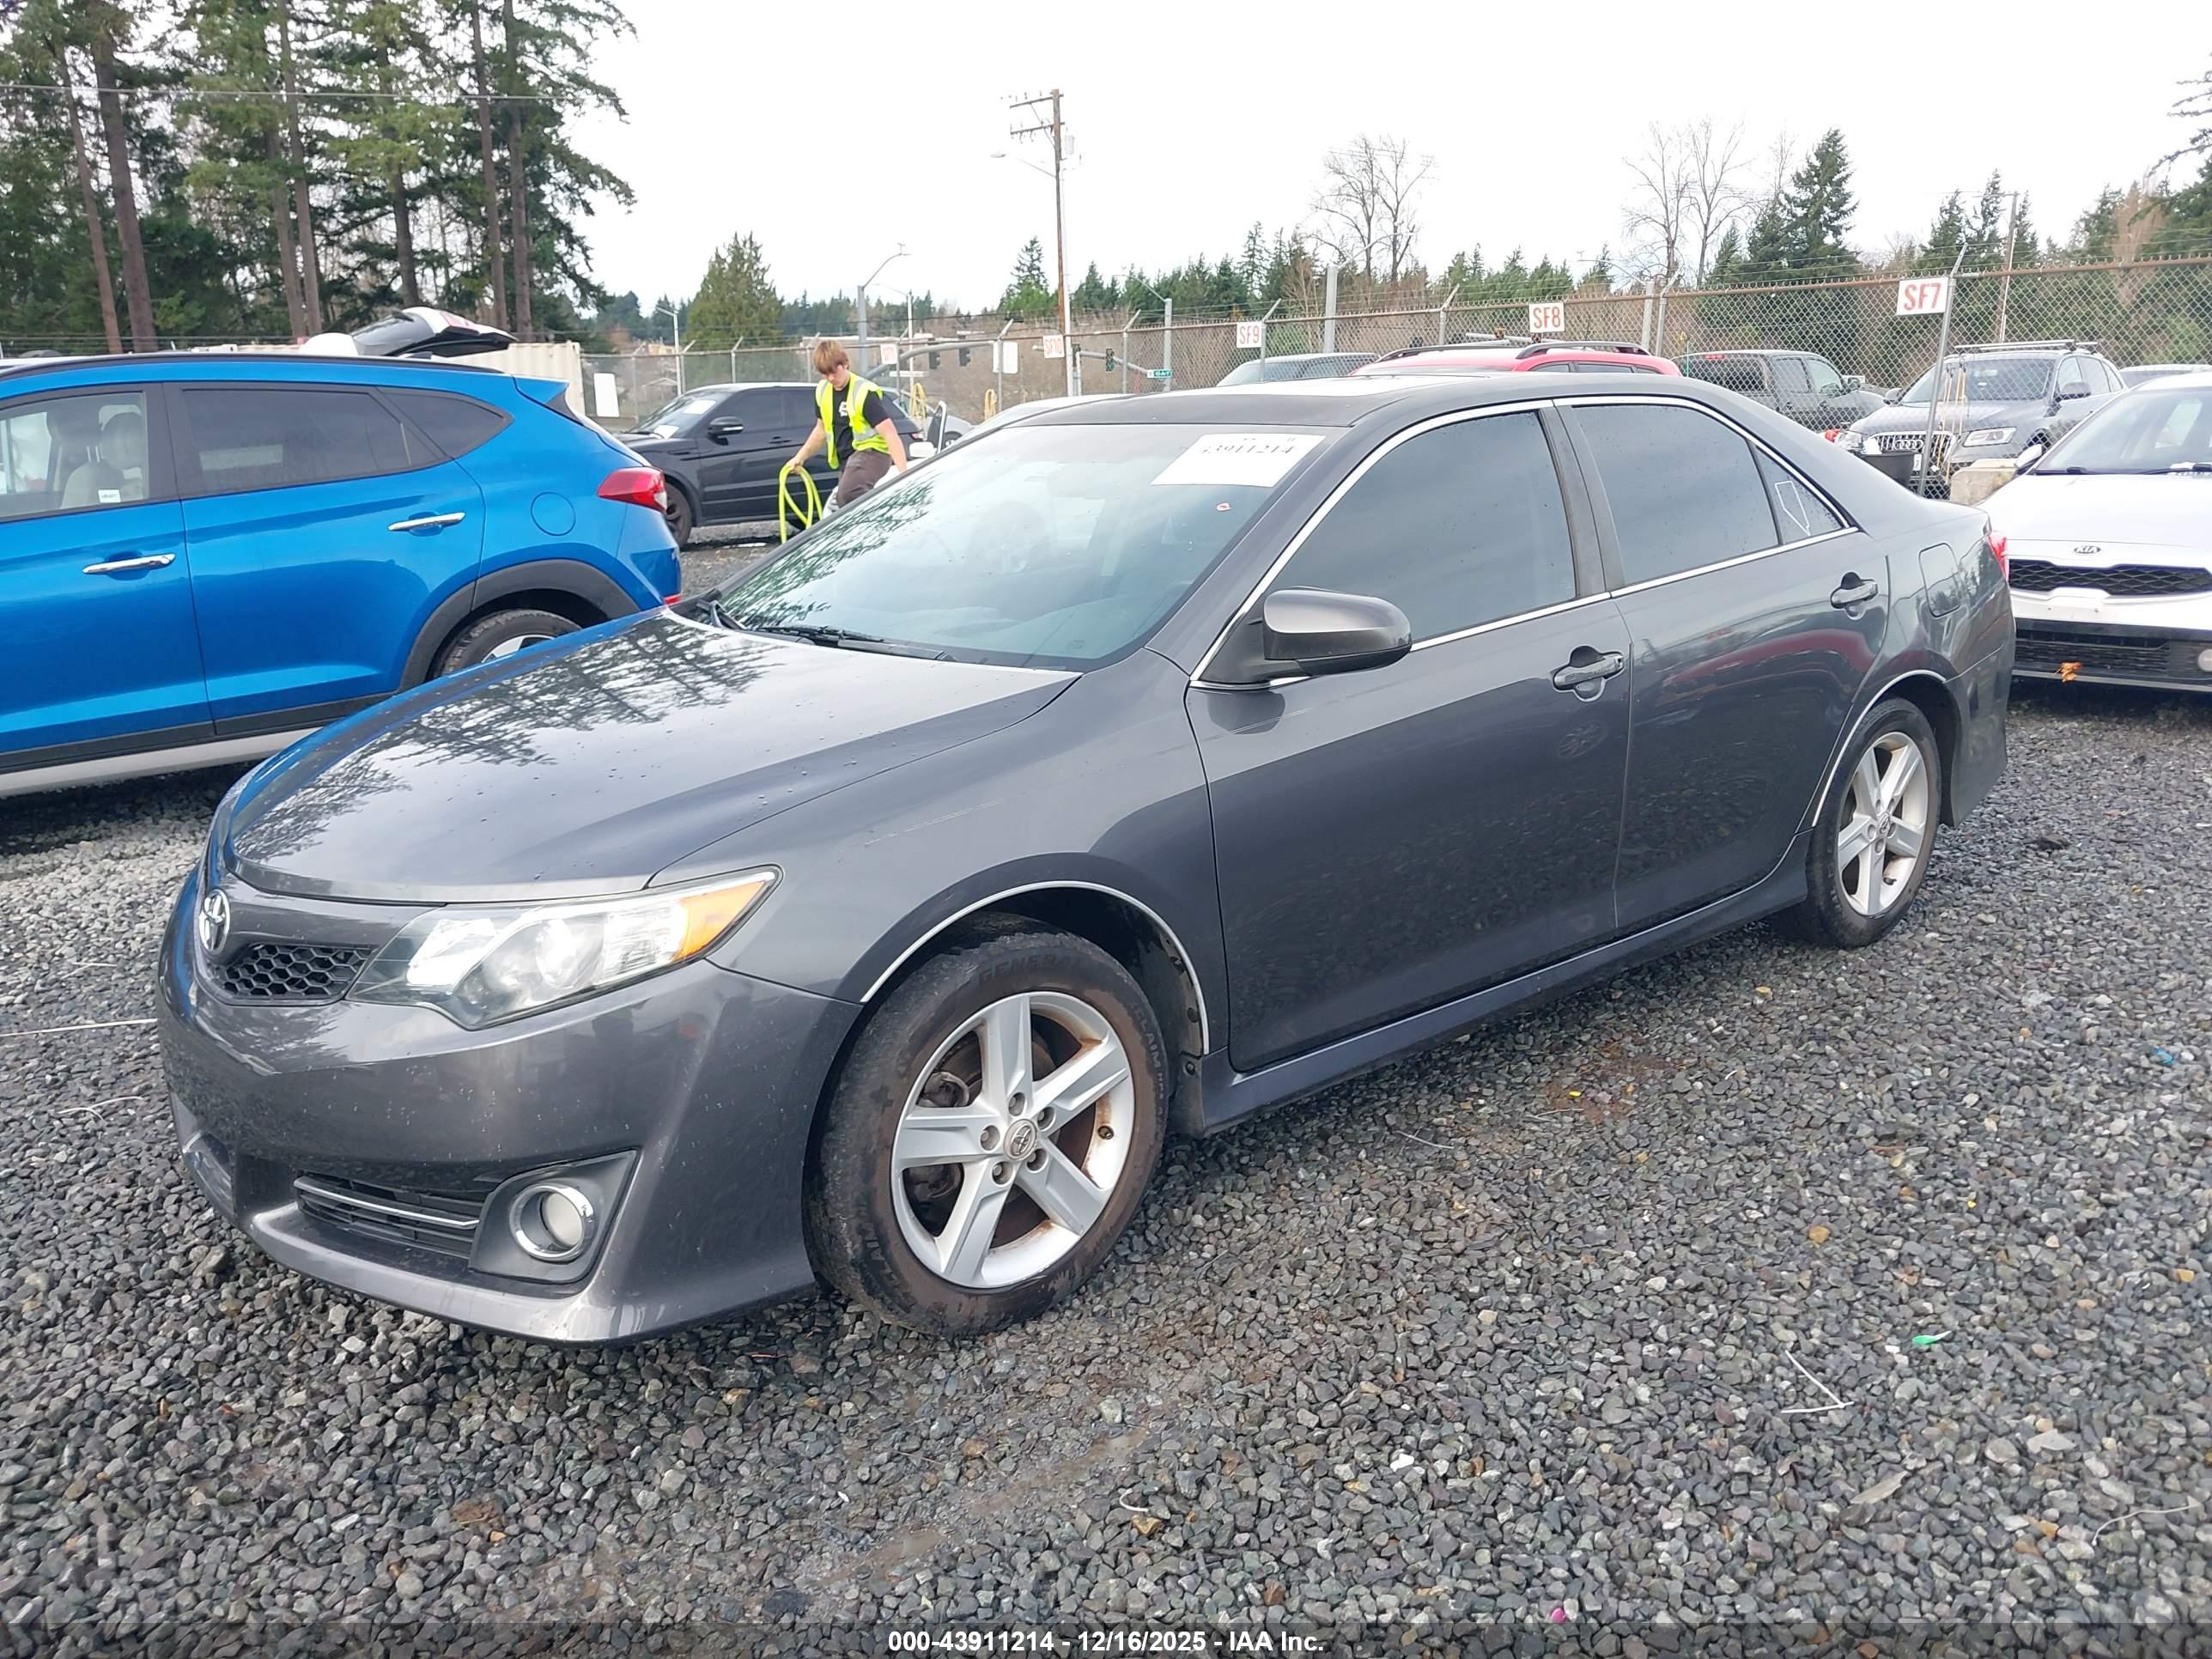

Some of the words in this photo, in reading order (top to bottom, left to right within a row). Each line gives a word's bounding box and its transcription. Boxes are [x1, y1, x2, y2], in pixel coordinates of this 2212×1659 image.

[1903, 283, 1942, 311] SF7
[1532, 305, 1561, 329] SF8
[1238, 325, 1260, 344] SF9
[2075, 544, 2100, 555] KIA
